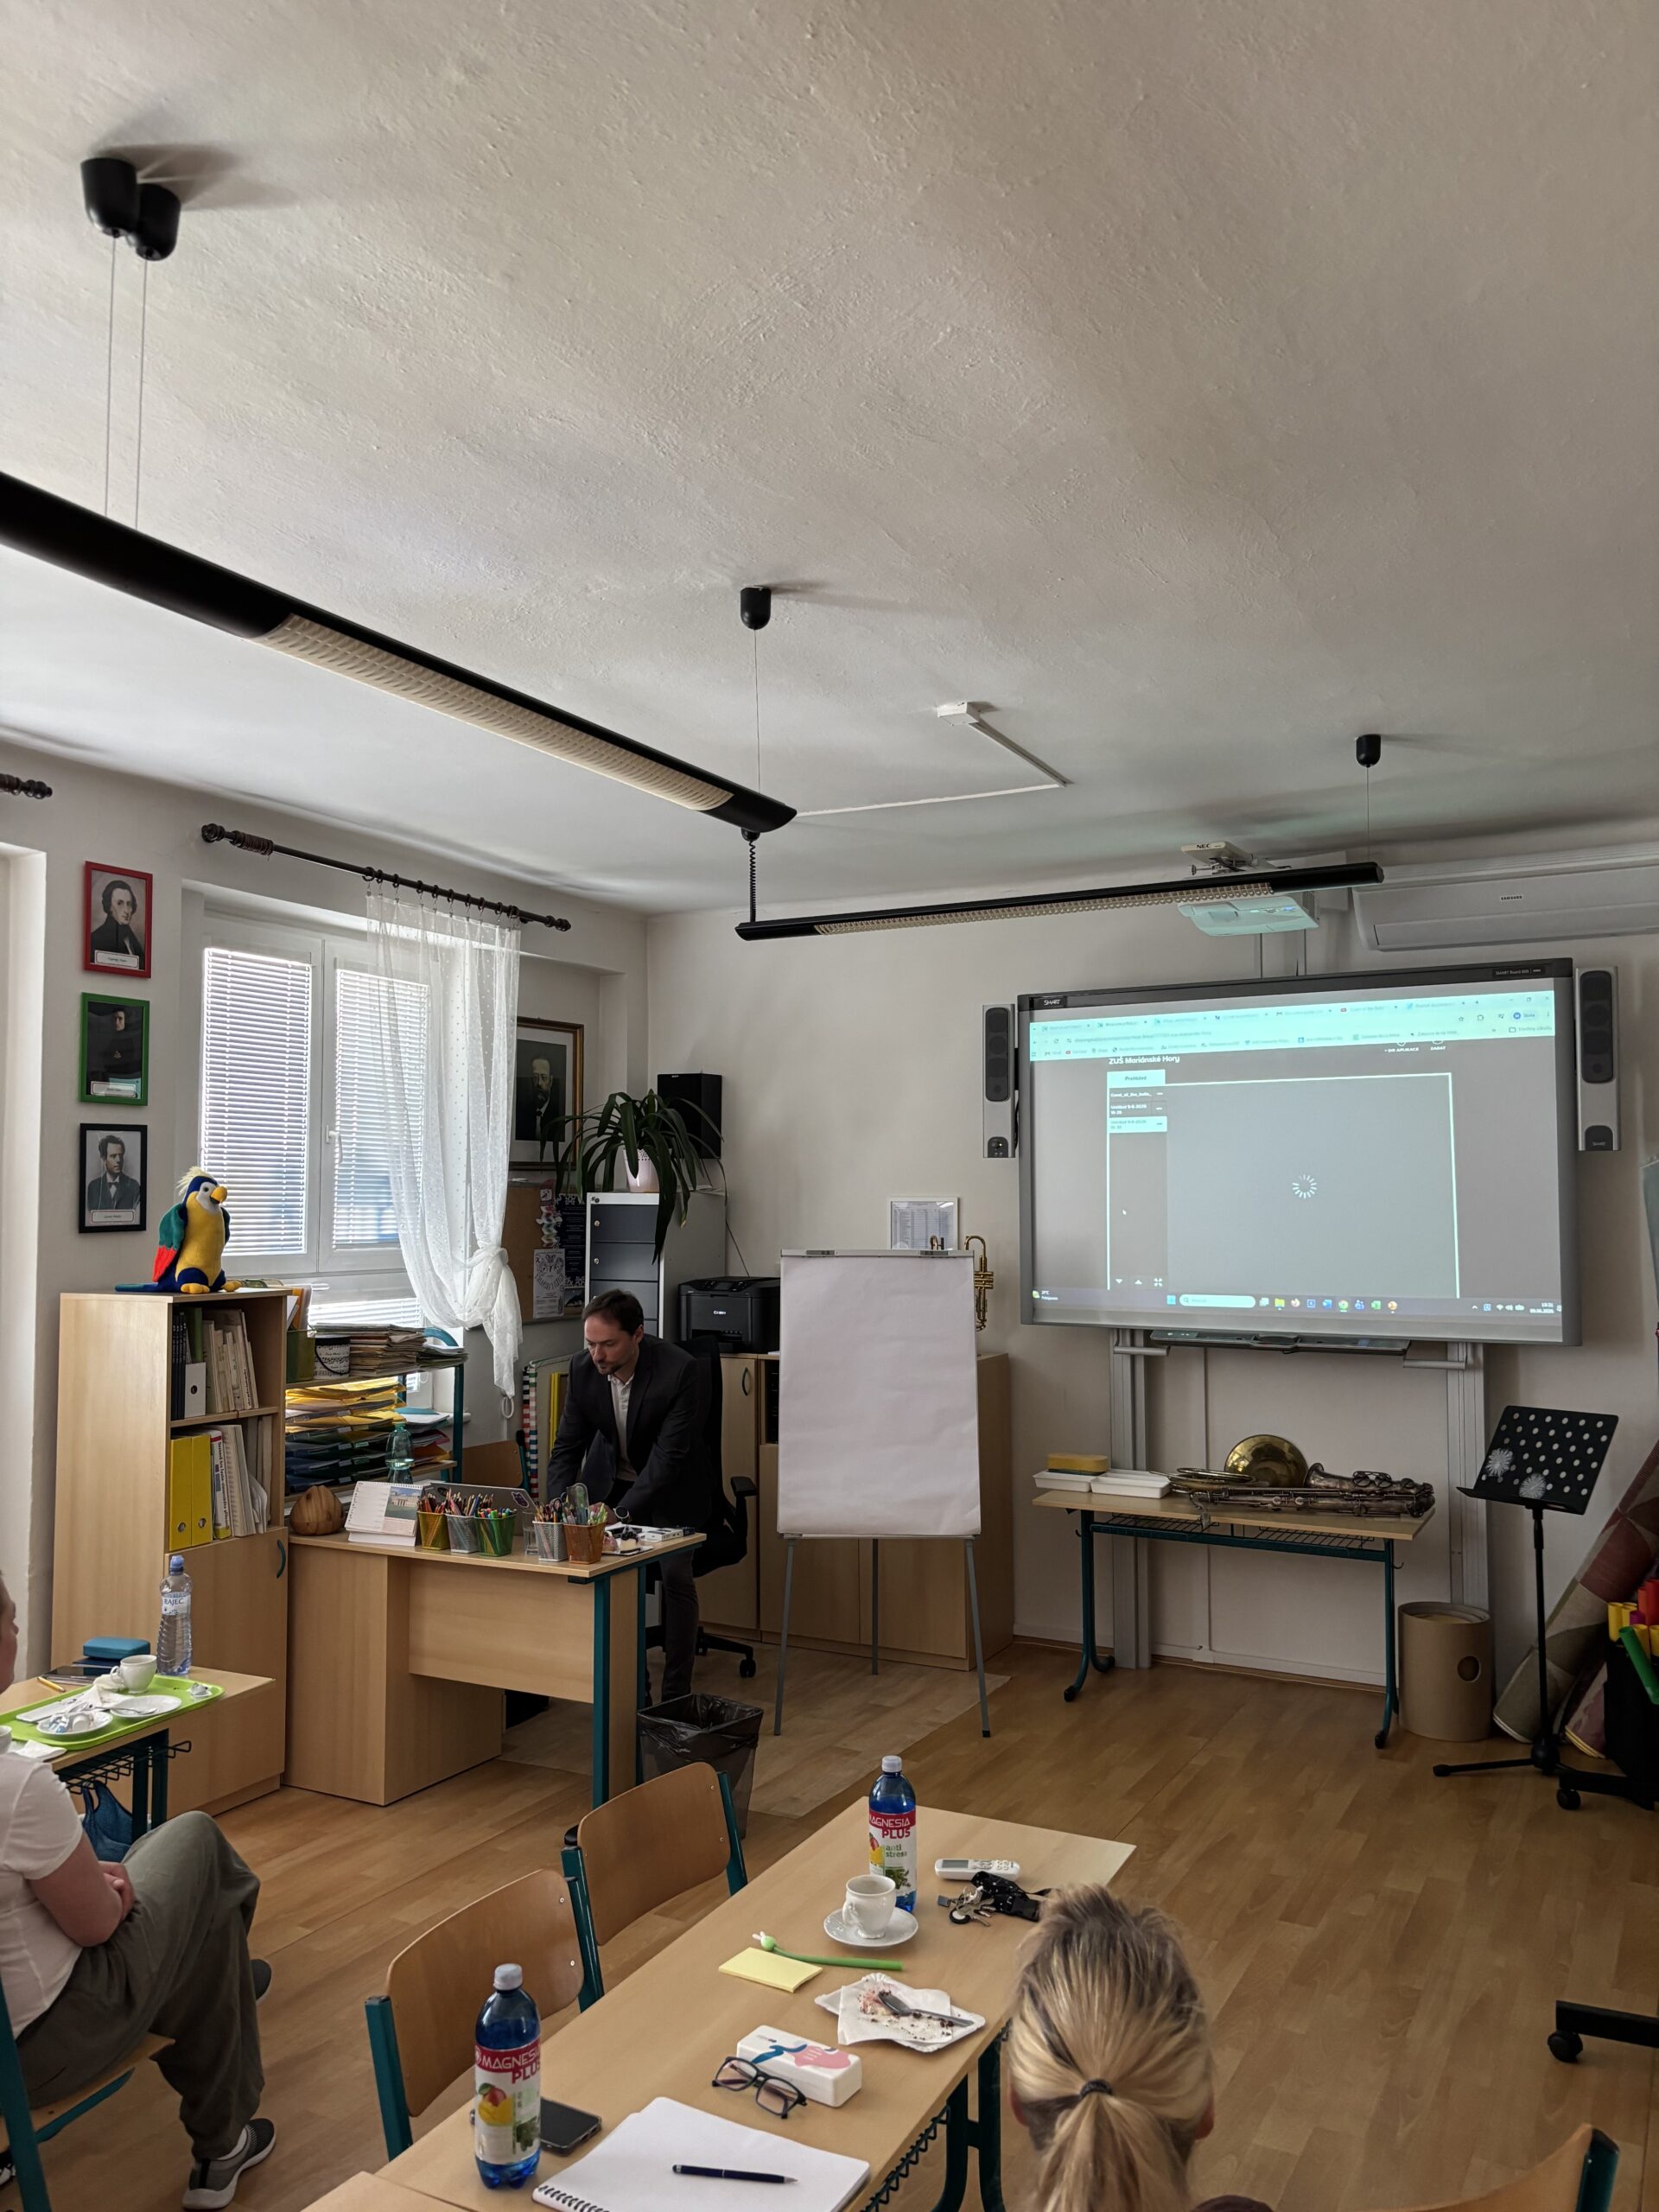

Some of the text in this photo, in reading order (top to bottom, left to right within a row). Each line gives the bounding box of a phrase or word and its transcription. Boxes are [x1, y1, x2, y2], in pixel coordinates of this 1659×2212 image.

[1109, 1056, 1124, 1065] ZUŠ
[1125, 1055, 1161, 1064] Mariánské
[164, 1598, 184, 1606] RAJEC
[882, 1827, 911, 1839] PLUS
